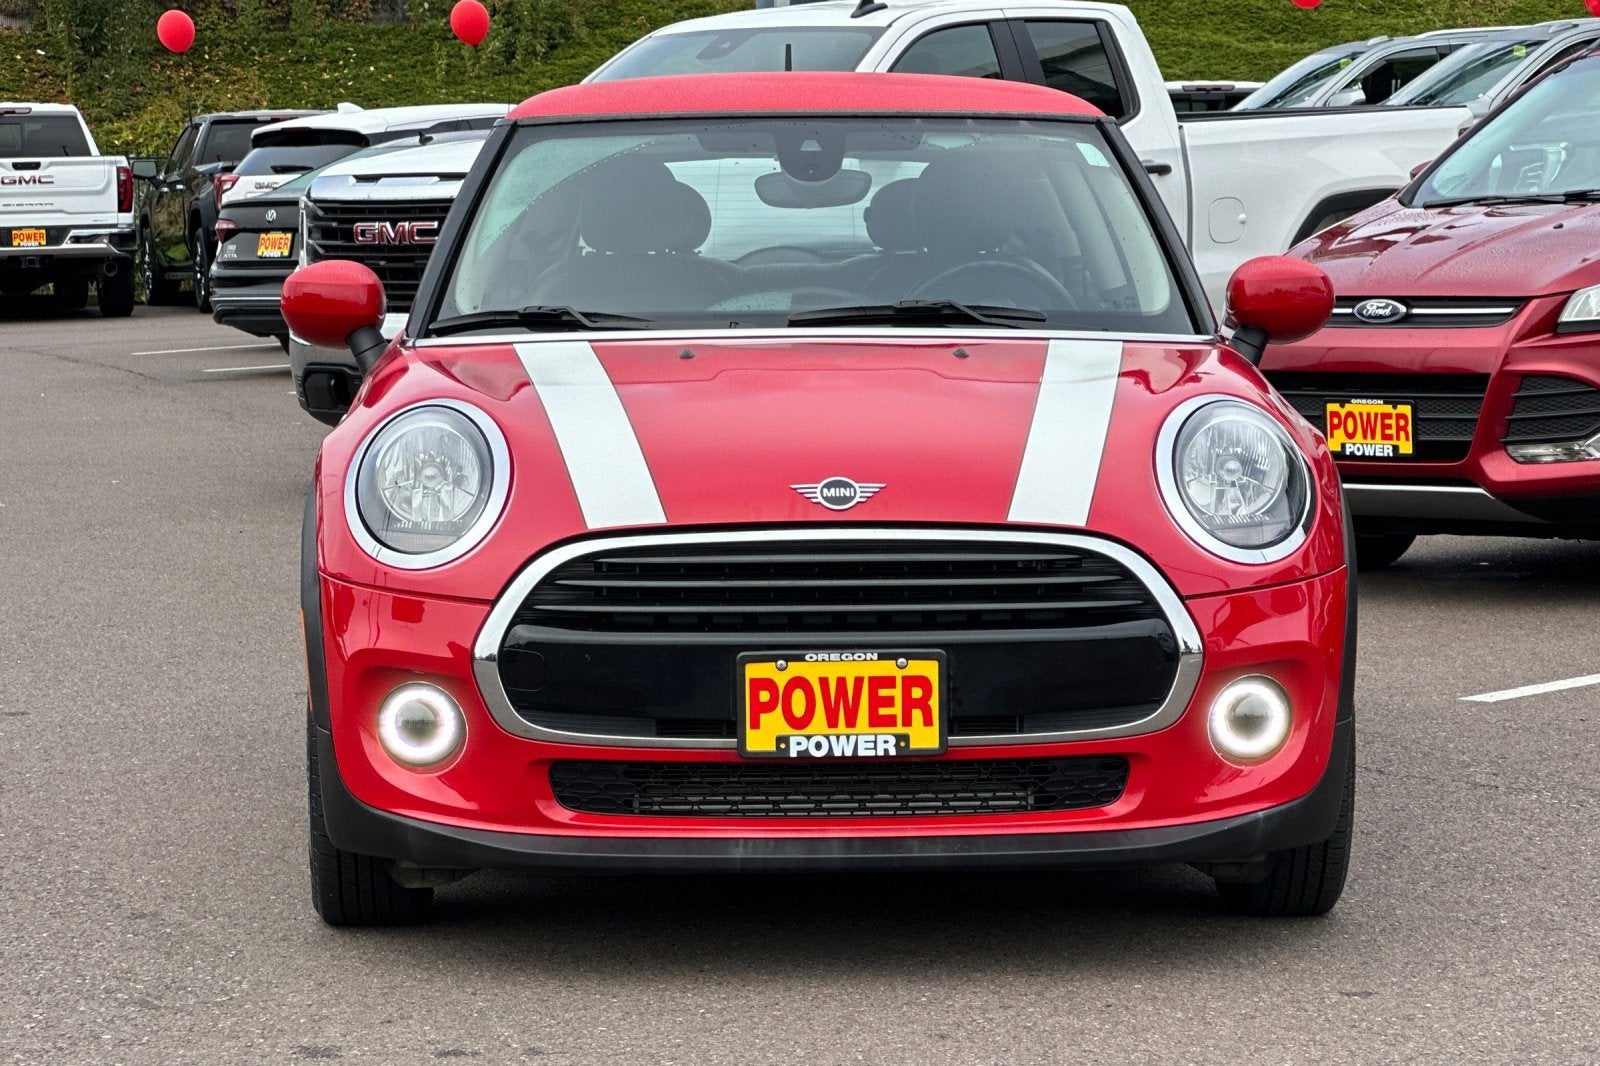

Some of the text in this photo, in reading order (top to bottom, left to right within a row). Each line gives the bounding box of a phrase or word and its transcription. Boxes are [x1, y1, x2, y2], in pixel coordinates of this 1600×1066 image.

[1, 175, 54, 185] GMC
[13, 232, 45, 242] POWER
[353, 221, 439, 245] GMC
[258, 236, 290, 250] POWER
[1363, 303, 1393, 317] Ford
[1329, 410, 1410, 442] POWER
[1345, 443, 1394, 457] POWER
[822, 487, 855, 497] MINI
[804, 652, 879, 662] OREGON
[749, 675, 934, 731] POWER
[789, 734, 897, 758] POWER
